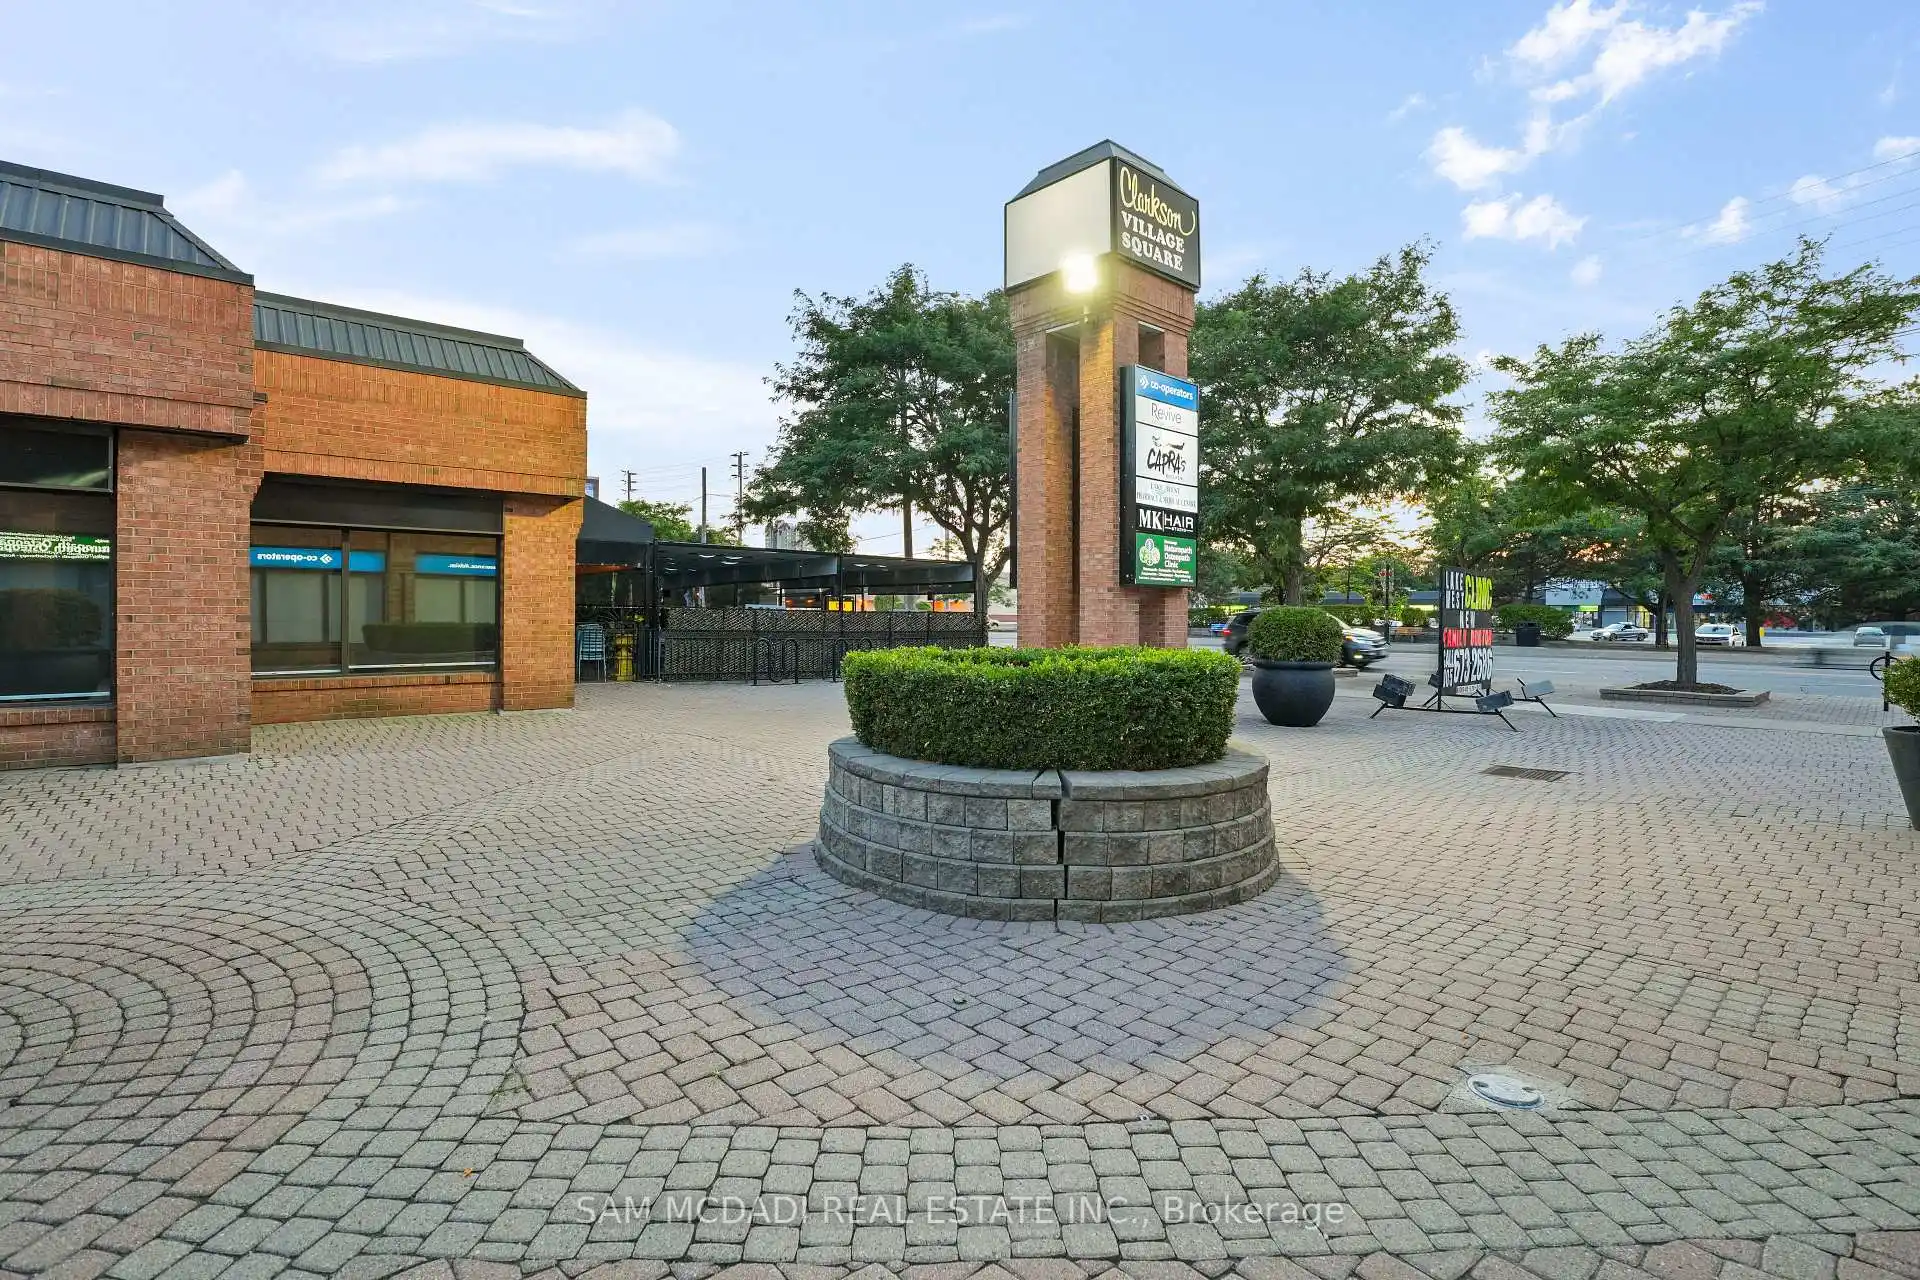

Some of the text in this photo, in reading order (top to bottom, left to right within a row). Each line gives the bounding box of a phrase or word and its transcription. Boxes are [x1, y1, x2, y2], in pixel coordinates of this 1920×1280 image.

[1120, 166, 1195, 236] Clarkson
[1121, 210, 1185, 254] VILLAGE
[1121, 231, 1183, 272] SQUARE
[1151, 380, 1193, 400] co-operators
[1151, 402, 1182, 424] Revive
[1139, 508, 1194, 530] MK HAIR
[1445, 591, 1464, 609] WEST
[1465, 575, 1493, 610] CLINIC
[1459, 610, 1476, 628] NEW
